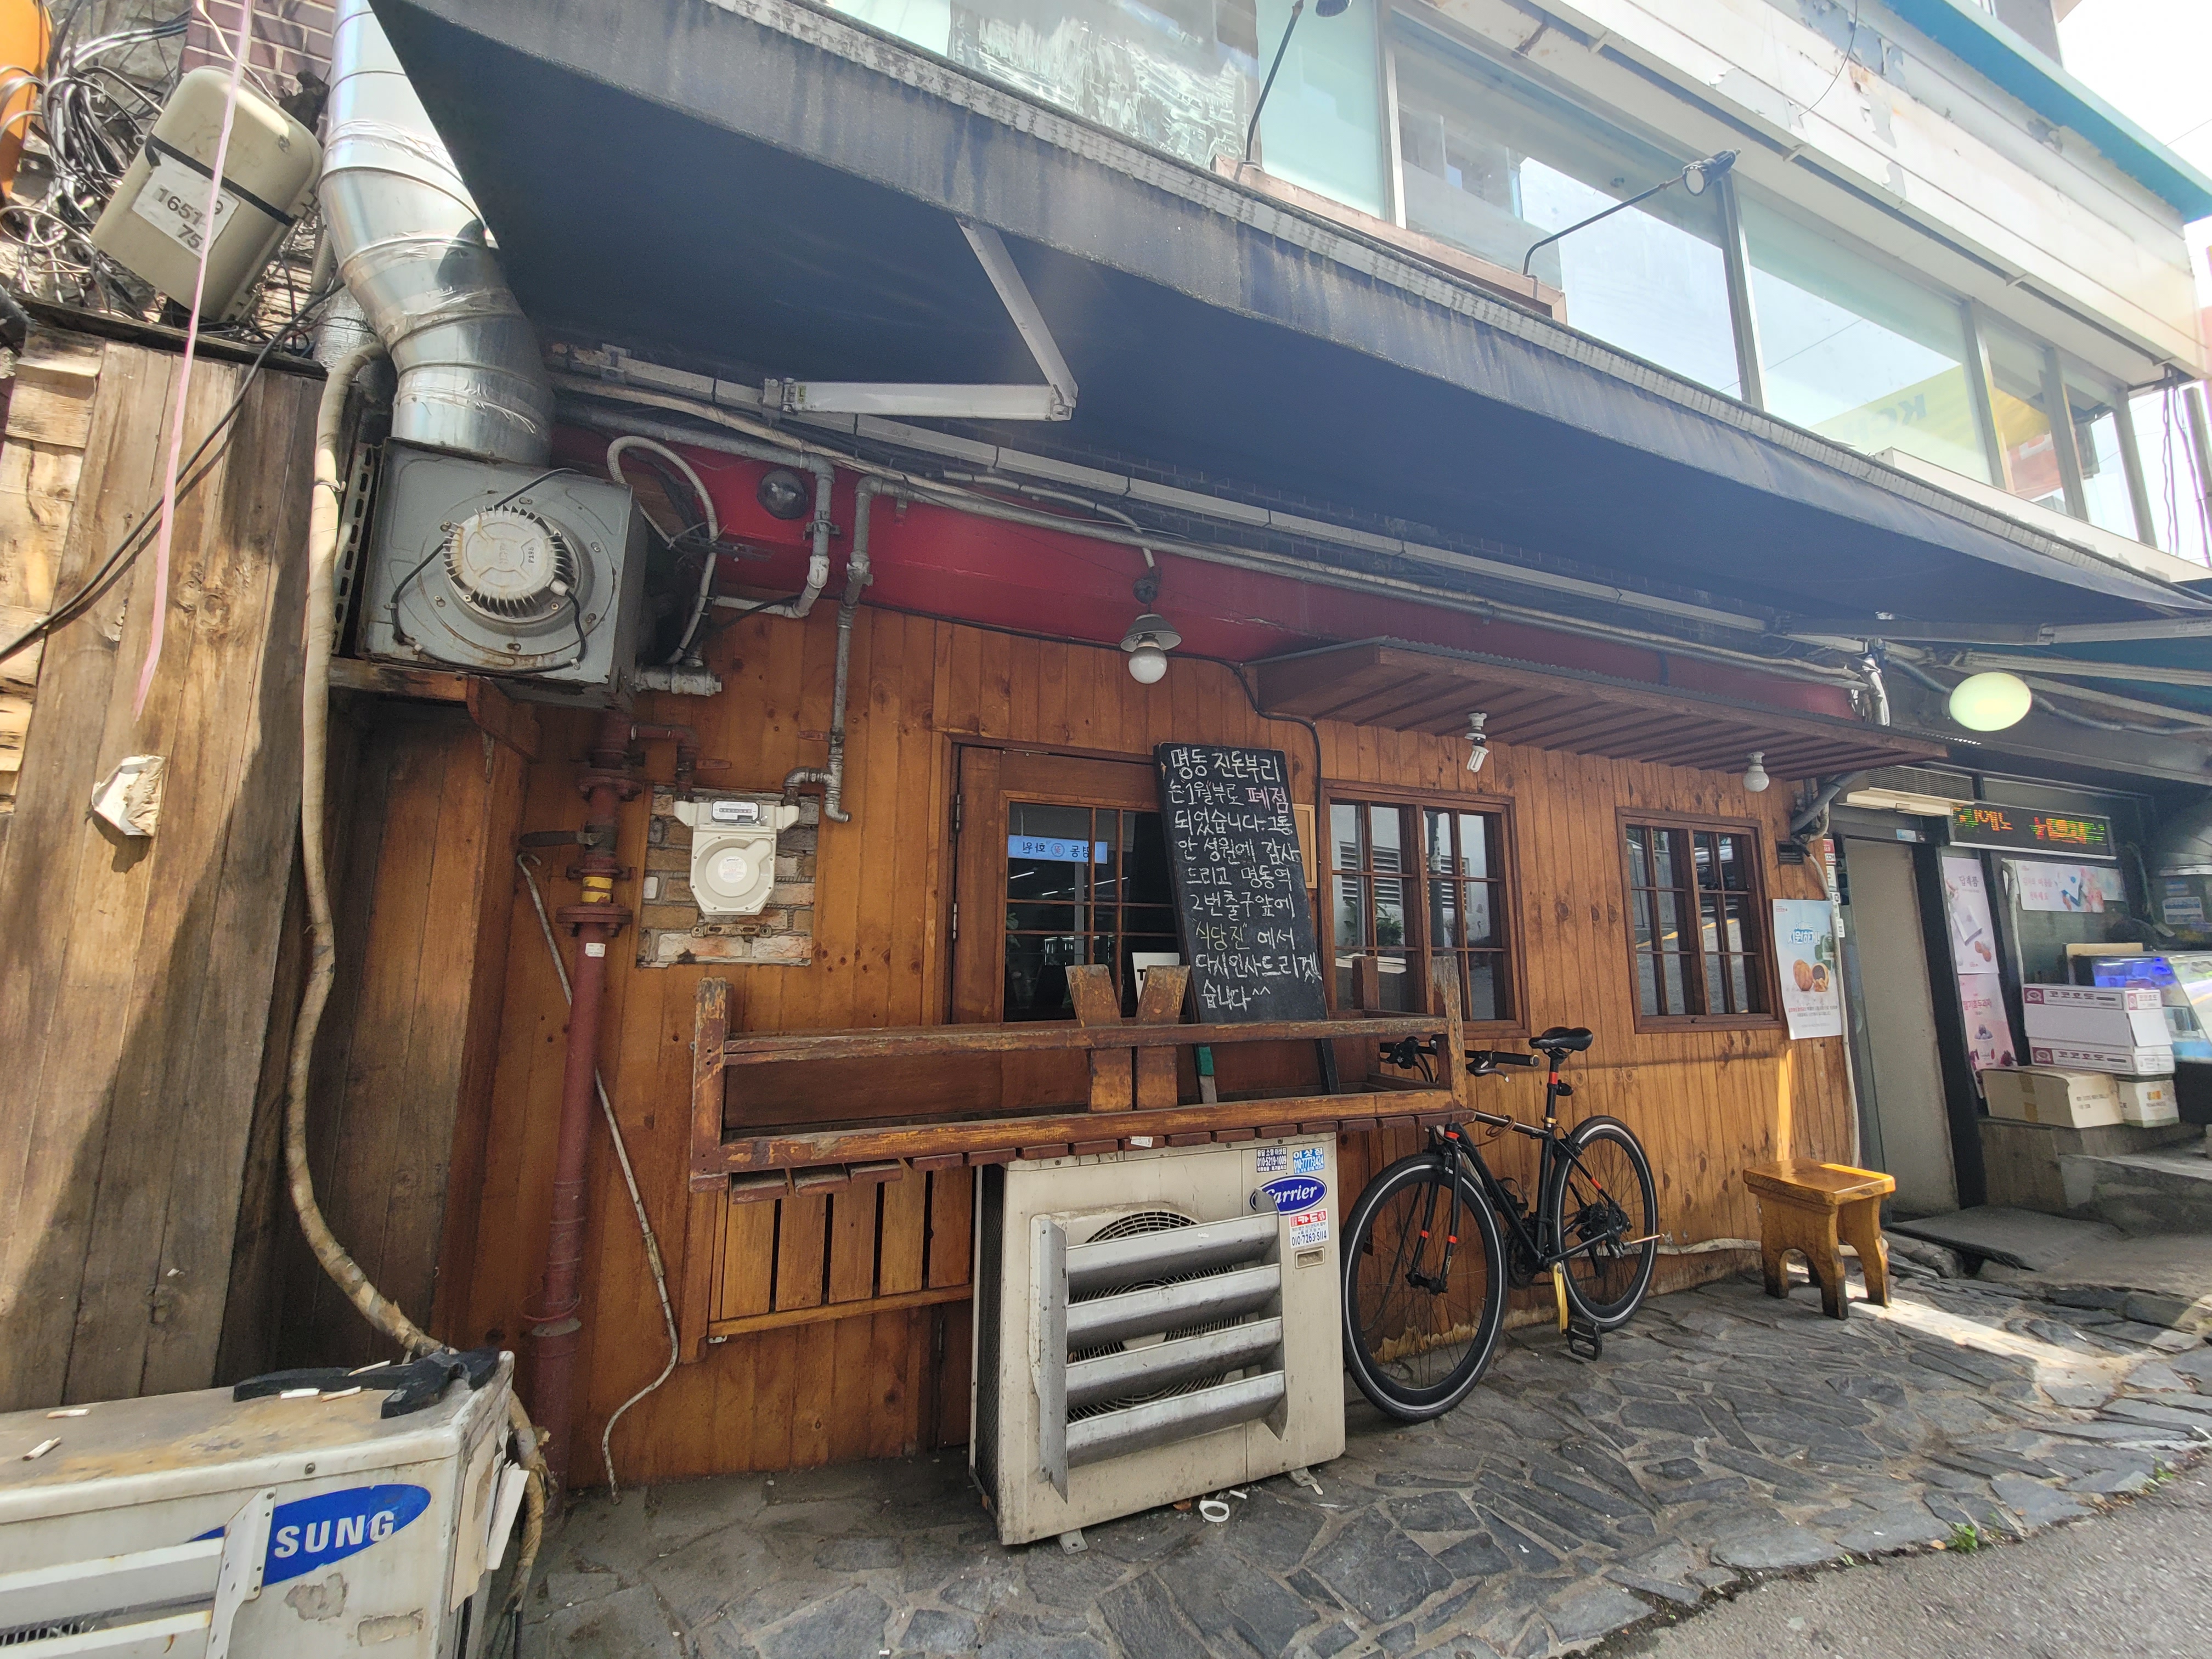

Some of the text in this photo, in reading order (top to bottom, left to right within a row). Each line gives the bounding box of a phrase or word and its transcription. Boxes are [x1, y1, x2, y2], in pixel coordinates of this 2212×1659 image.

[177, 224, 205, 249] 75
[1170, 747, 1281, 783] 명동 진돈부리
[1245, 785, 1289, 814] 폐점
[1178, 836, 1301, 865] 안 성원에 감사
[1186, 865, 1293, 892] 드리고 명동역
[1257, 927, 1295, 950] 에서
[2049, 991, 2095, 1000] 코코호도
[2058, 1051, 2105, 1062] 코코호도
[1257, 1155, 1286, 1167] 010-5219-1009
